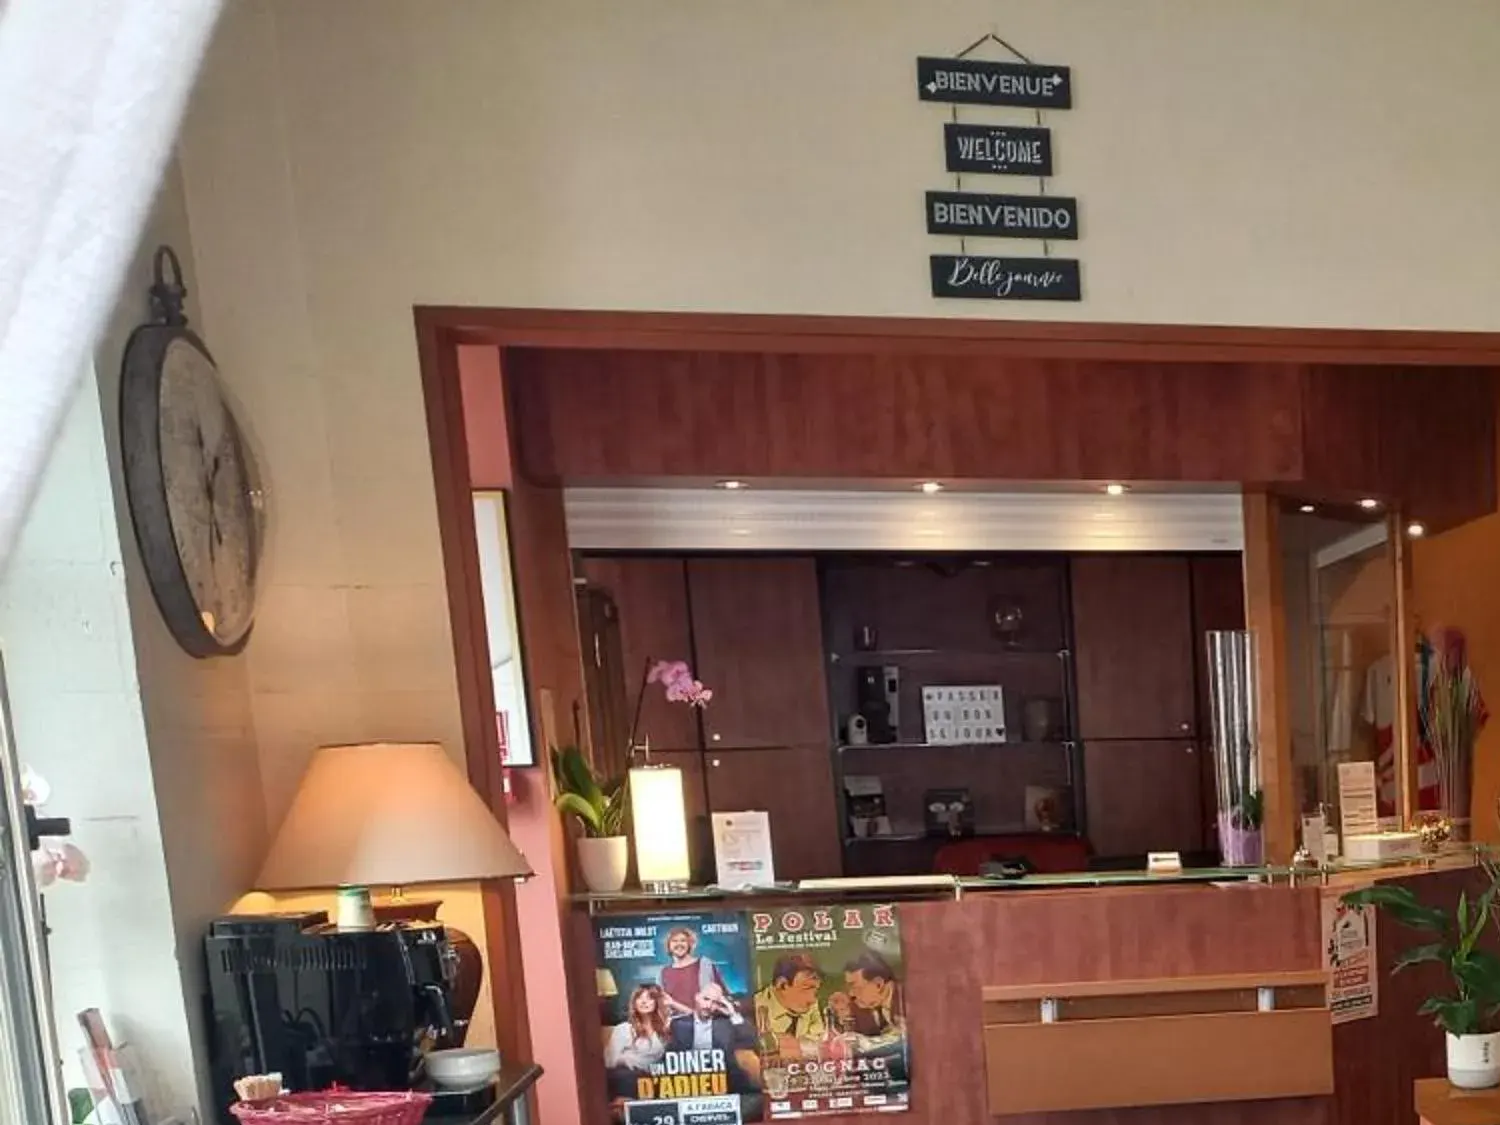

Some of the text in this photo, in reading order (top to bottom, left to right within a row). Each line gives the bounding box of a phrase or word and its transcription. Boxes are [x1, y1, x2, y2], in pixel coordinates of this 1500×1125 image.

[935, 70, 1054, 97] BIENVENUE
[957, 136, 1043, 164] WELCOME
[933, 203, 1071, 229] BIENVENIDO
[948, 258, 1001, 286] Belle
[752, 904, 895, 932] POLAR
[755, 930, 838, 945] Le Festival
[787, 1057, 886, 1075] COGNAC
[637, 1073, 729, 1098] D'ADIEU
